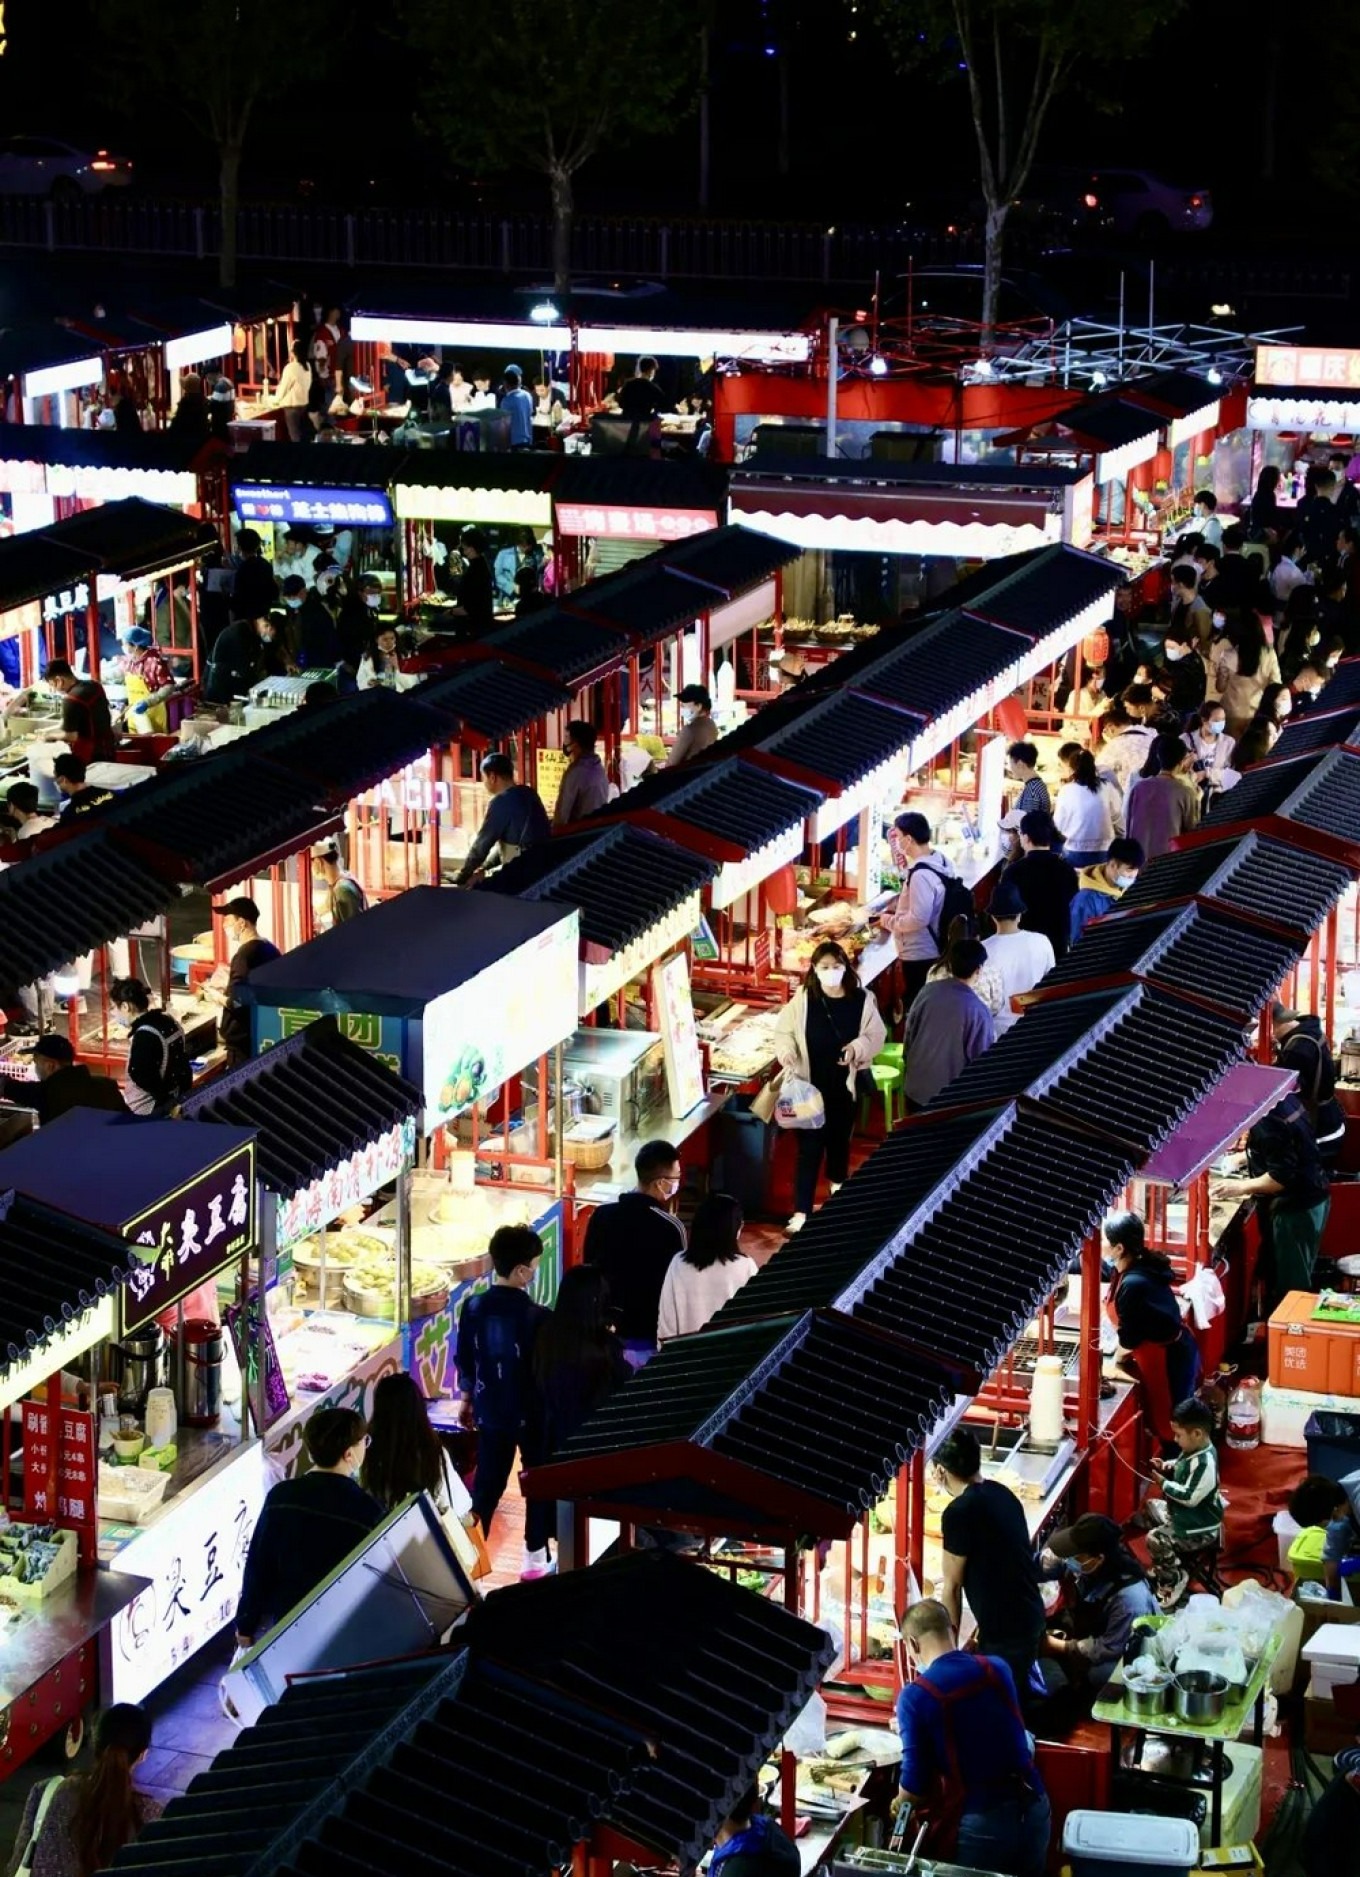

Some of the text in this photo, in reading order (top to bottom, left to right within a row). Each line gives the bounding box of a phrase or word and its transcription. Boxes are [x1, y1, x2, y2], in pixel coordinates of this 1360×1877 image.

[177, 1173, 249, 1265] 臭豆腐
[27, 1411, 87, 1443] 刷酱豆腐
